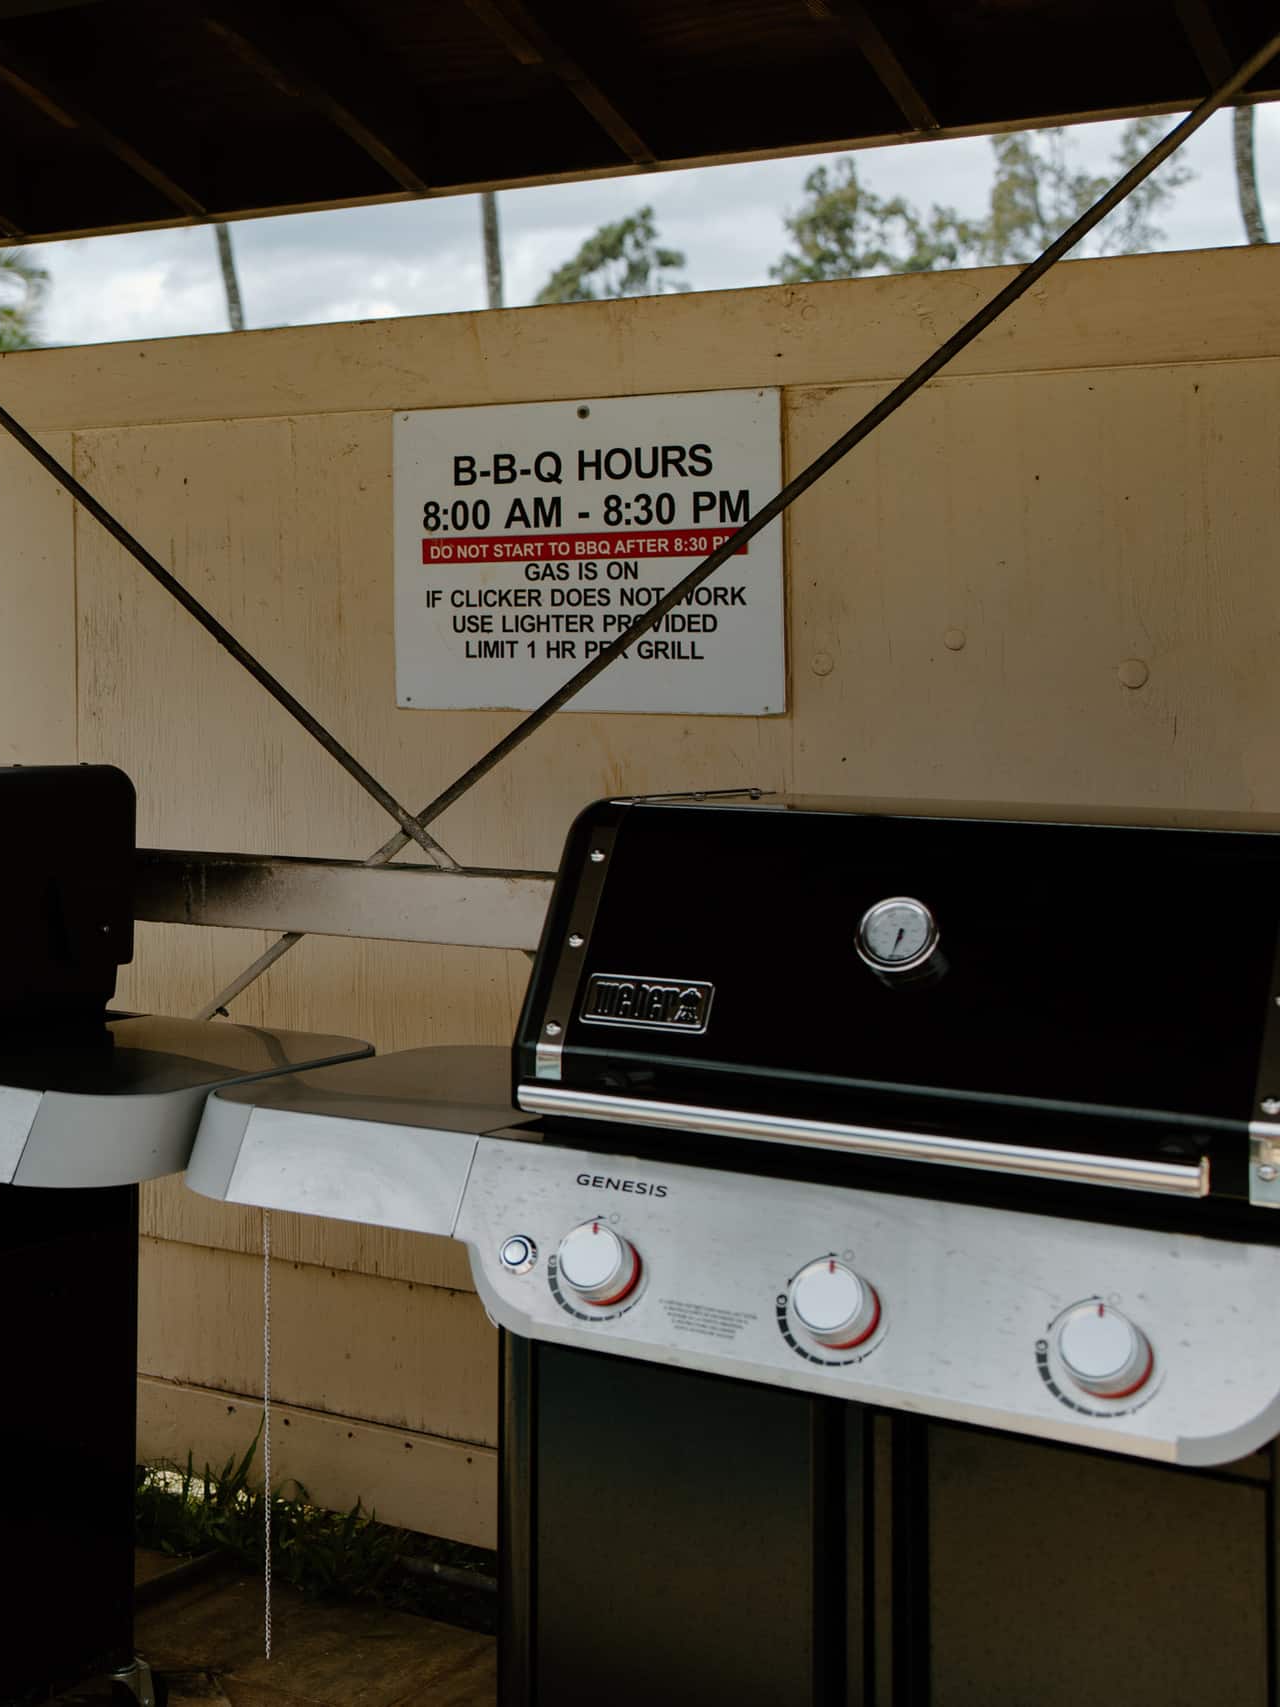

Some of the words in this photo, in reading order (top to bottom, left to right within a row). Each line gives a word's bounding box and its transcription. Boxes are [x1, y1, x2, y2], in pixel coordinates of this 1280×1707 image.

[454, 451, 563, 486] B-B-Q
[578, 443, 713, 481] HOURS
[422, 500, 491, 532] 8:00
[504, 496, 562, 529] AM
[578, 511, 590, 519] -
[603, 493, 676, 526] 8:30
[693, 489, 750, 524] PM
[430, 545, 453, 560] DO
[457, 544, 489, 559] NOT
[493, 542, 544, 558] START
[548, 541, 570, 556] TO
[575, 540, 611, 555] BBQ
[614, 538, 669, 554] AFTER
[674, 536, 708, 551] 8:30
[524, 563, 570, 581] GAS
[578, 562, 598, 581] IS
[606, 561, 639, 580] ON
[426, 590, 443, 608] IF
[450, 589, 543, 608] CLICKER
[550, 588, 611, 607] DOES
[620, 587, 665, 606] NOT
[452, 615, 494, 633] USE
[502, 615, 594, 633] LIGHTER
[465, 640, 519, 659] LIMIT
[527, 640, 536, 659] 1
[546, 640, 576, 659] HR
[585, 641, 629, 659] PE
[637, 640, 705, 660] GRILL
[576, 1173, 669, 1198] GENESIS
